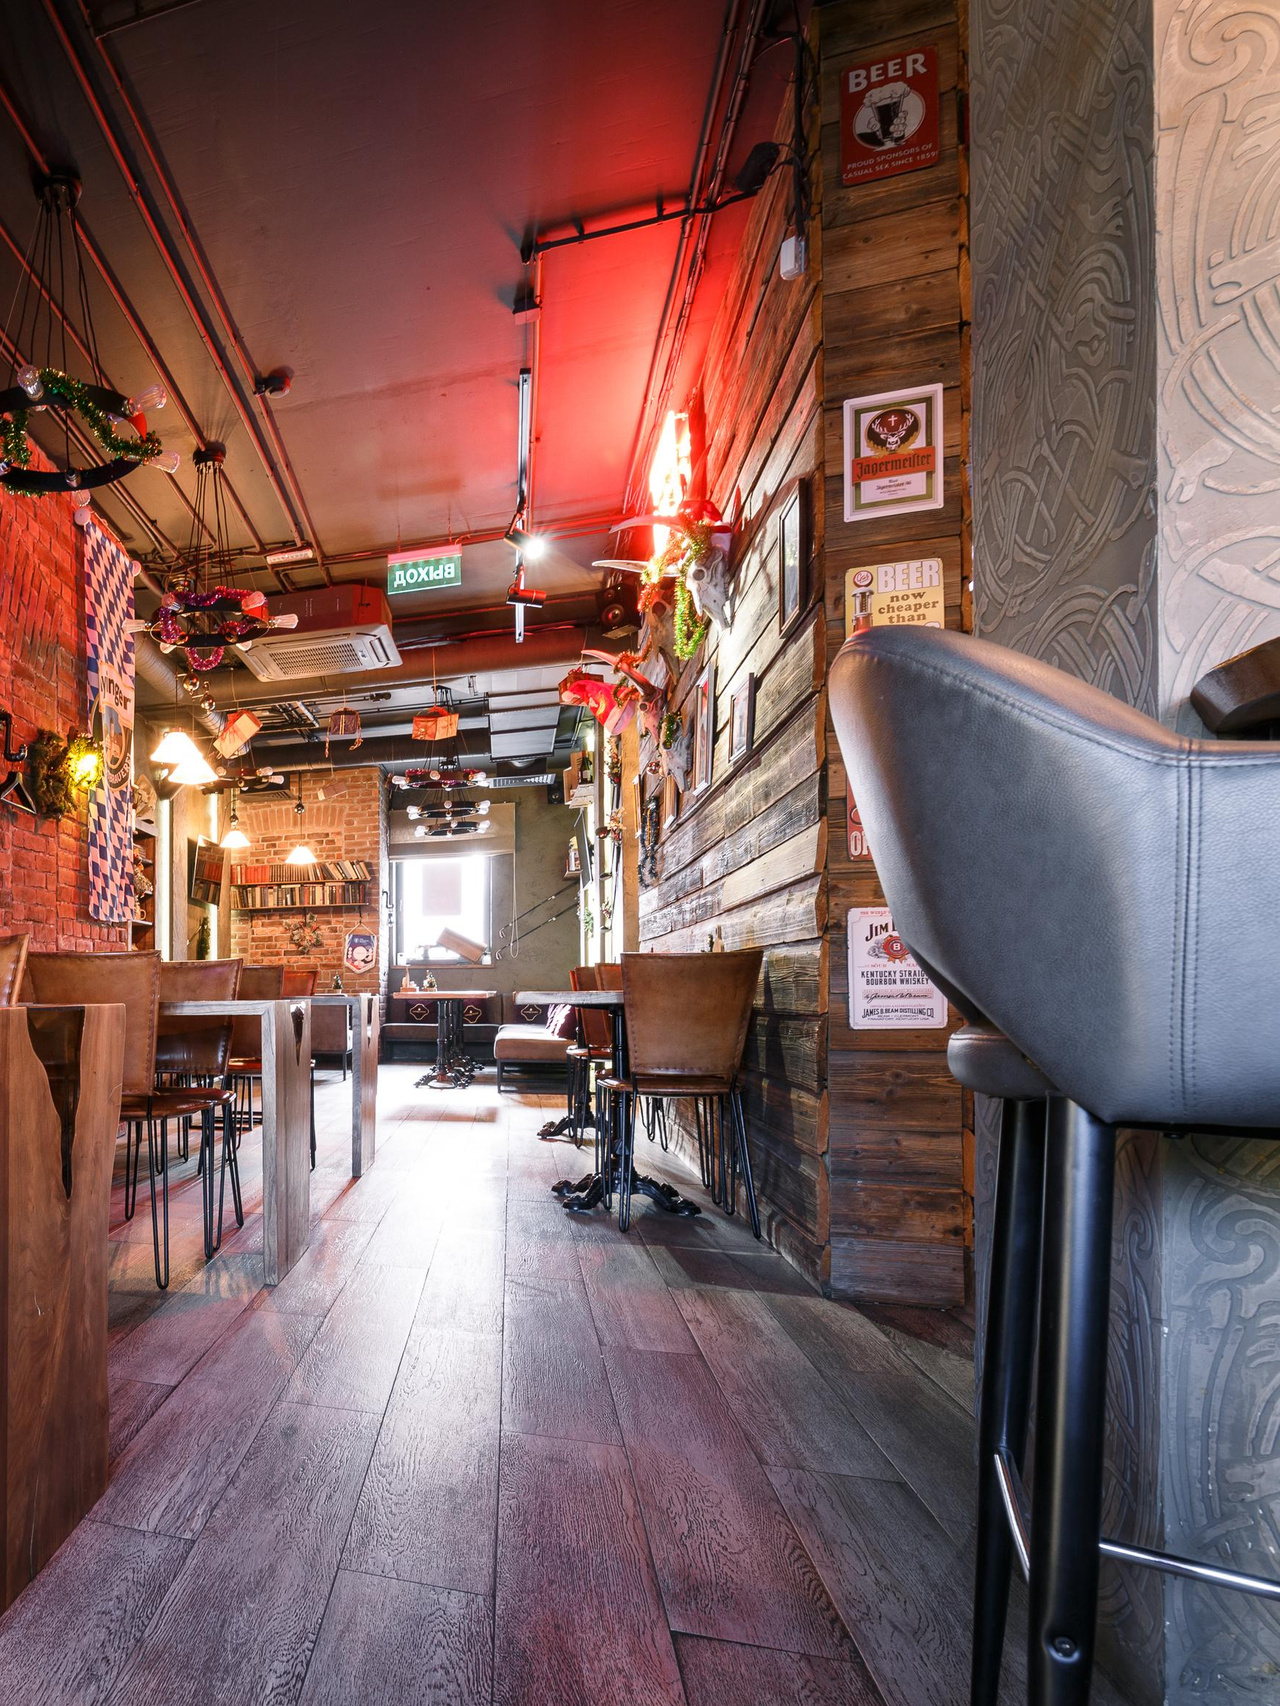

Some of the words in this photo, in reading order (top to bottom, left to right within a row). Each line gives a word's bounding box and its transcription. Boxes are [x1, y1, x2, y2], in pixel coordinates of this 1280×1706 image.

[848, 54, 927, 93] BEER
[847, 158, 874, 169] PROUD
[877, 147, 920, 162] SPONSORS
[843, 168, 873, 179] CASUAL
[891, 157, 913, 167] SINCE
[877, 560, 940, 594] BEER
[890, 592, 926, 603] now
[878, 601, 939, 614] cheaper
[888, 613, 926, 624] than
[101, 671, 131, 710] yinger
[865, 923, 889, 942] JIM
[899, 970, 928, 978] STRAIG
[862, 1008, 879, 1018] JAMES
[900, 1008, 926, 1016] DISTILLING
